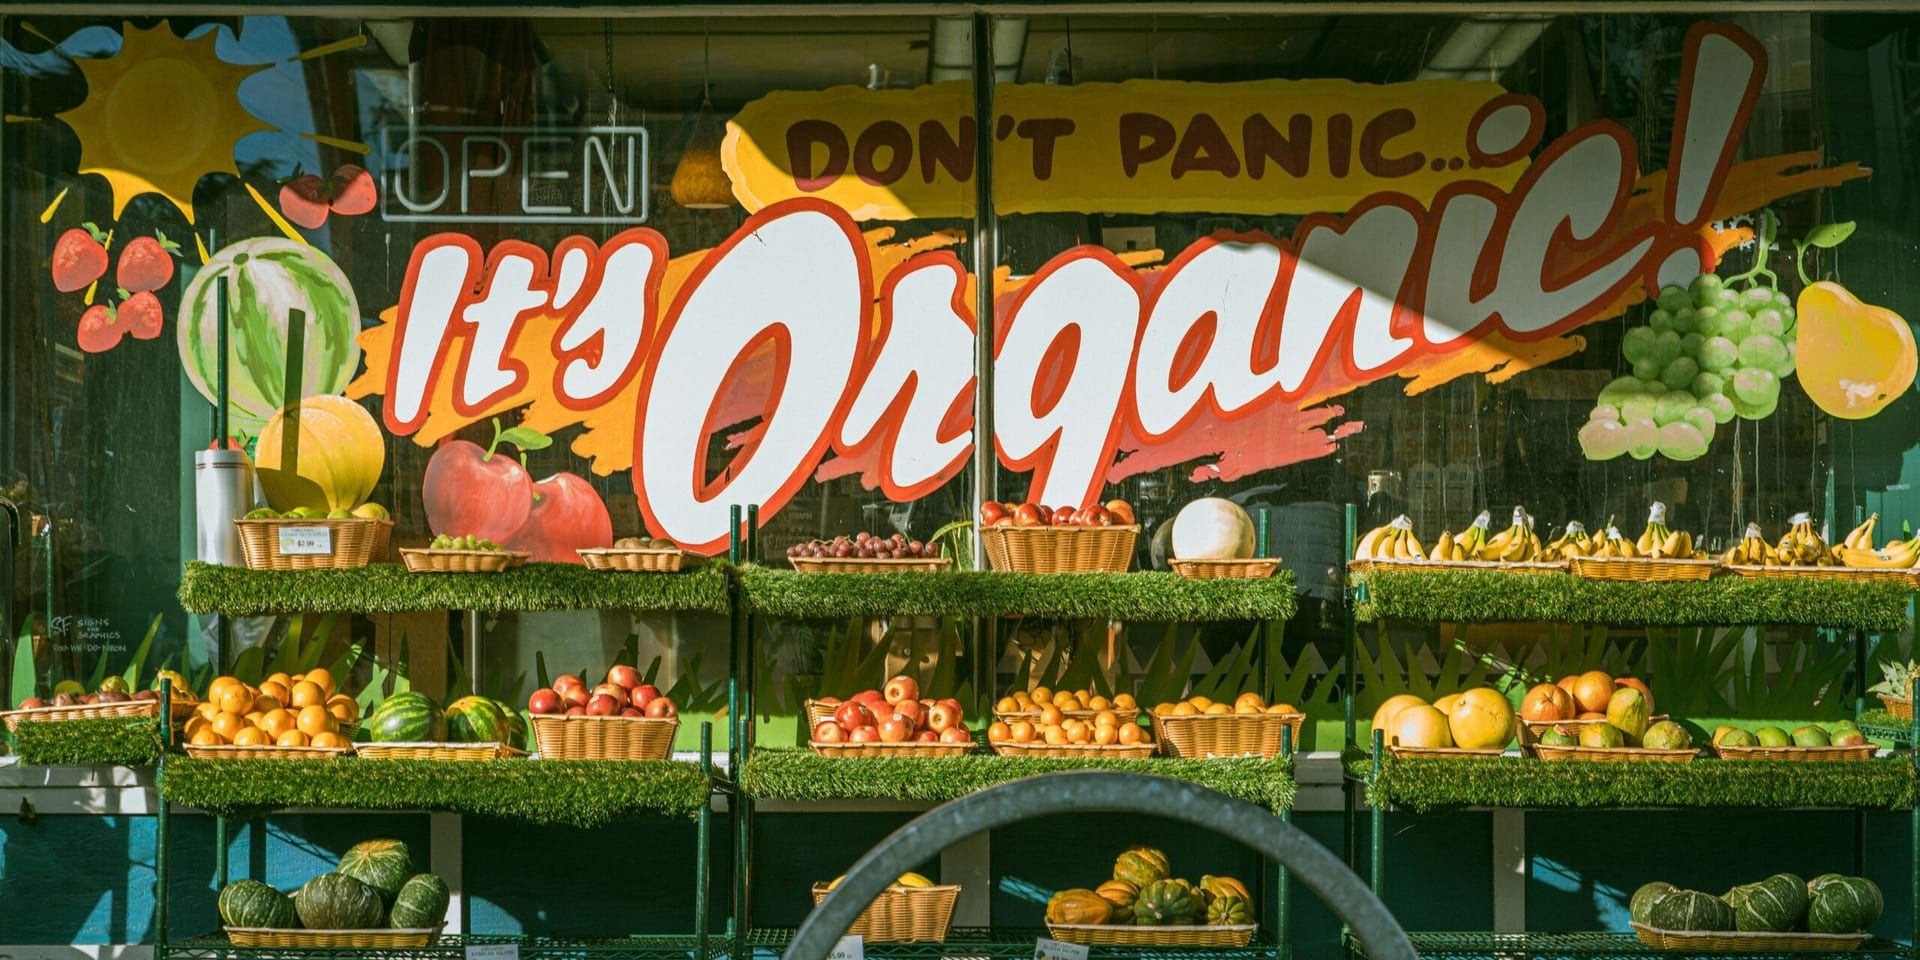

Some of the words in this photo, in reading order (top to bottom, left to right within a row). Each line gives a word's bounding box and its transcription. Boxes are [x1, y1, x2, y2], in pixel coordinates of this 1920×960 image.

[395, 136, 635, 213] OPEN
[786, 113, 1075, 192] DON'T
[383, 227, 668, 436] It's
[631, 20, 1769, 556] Organic!
[77, 618, 110, 627] SIGNS
[77, 631, 121, 640] GRAPHICS
